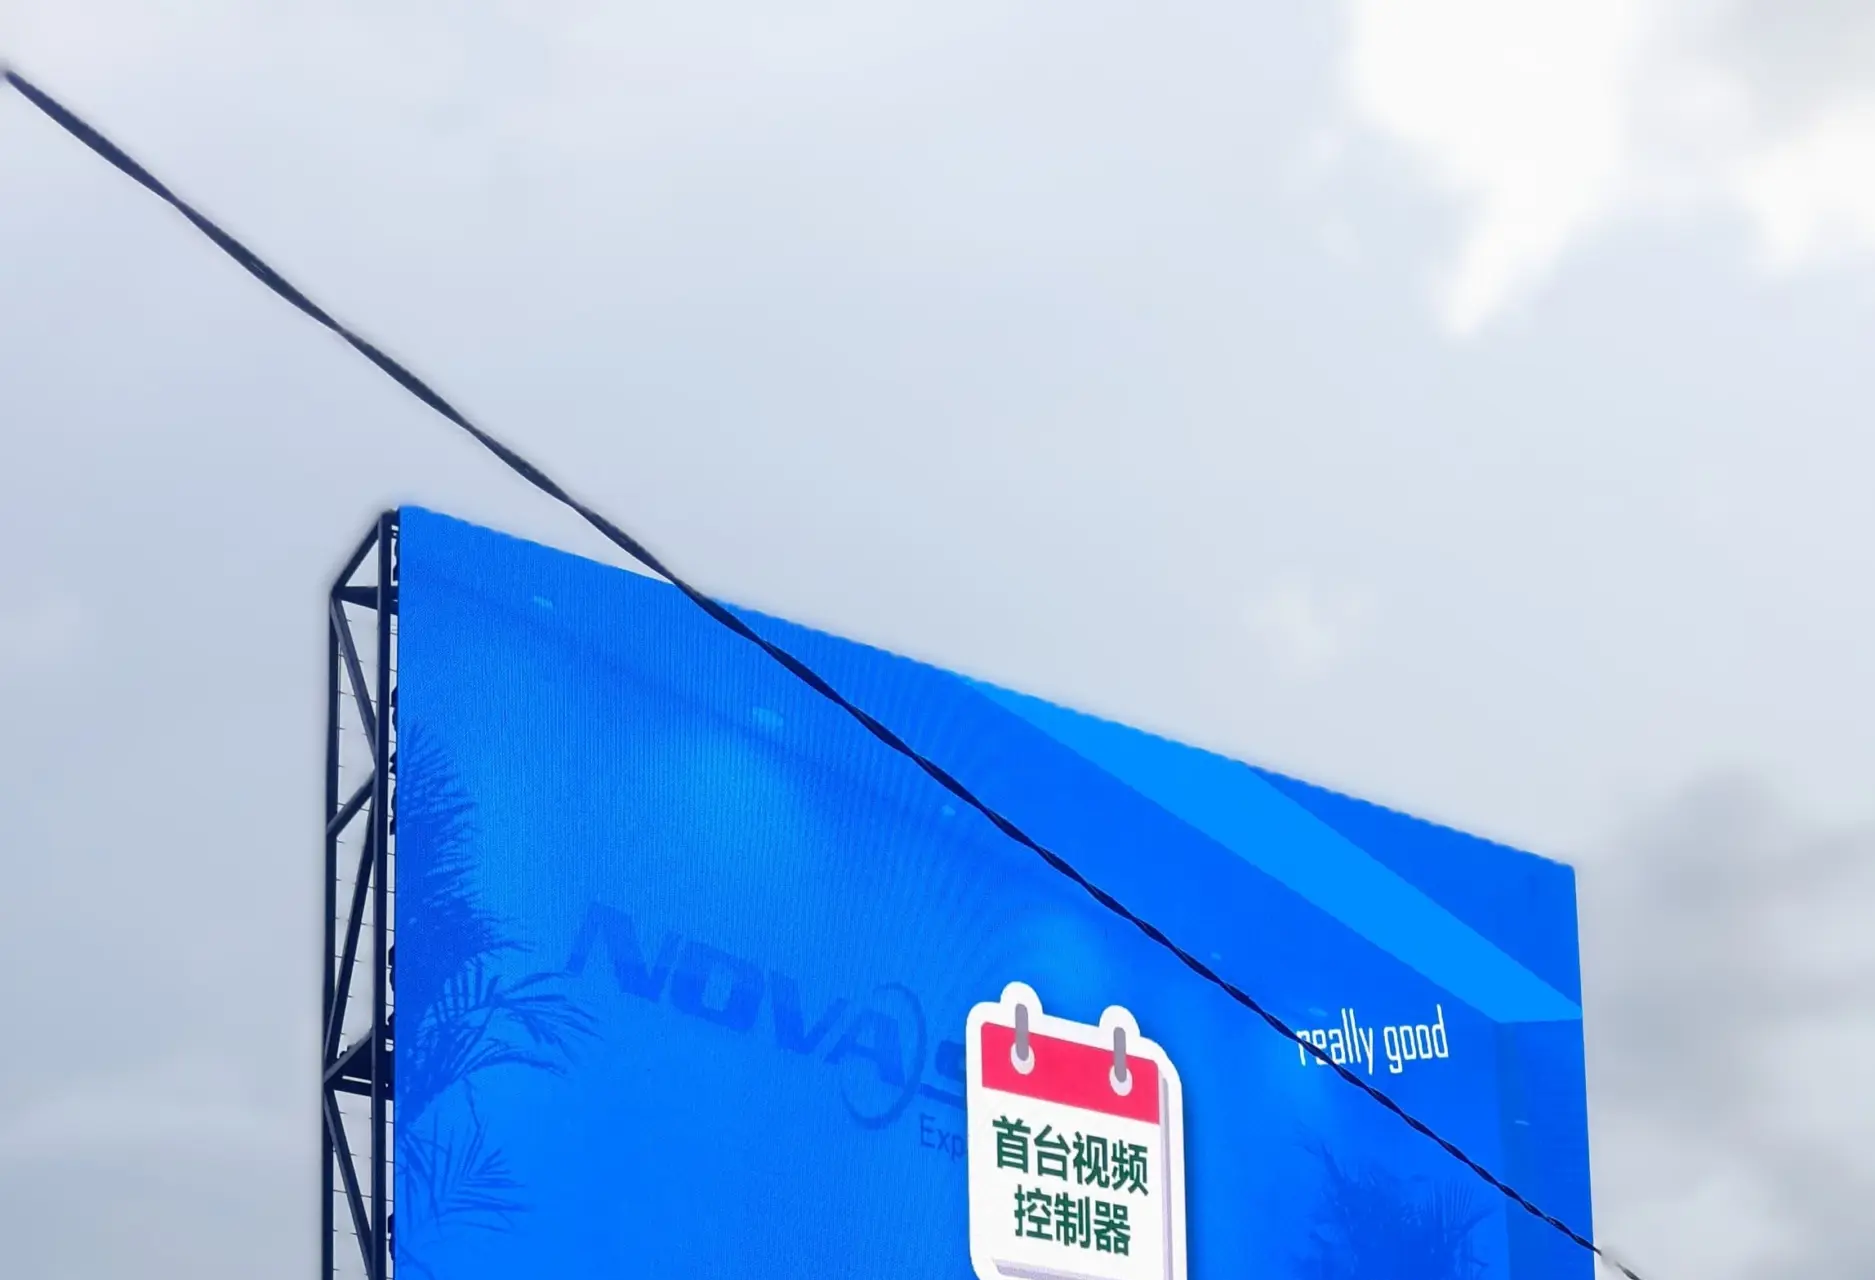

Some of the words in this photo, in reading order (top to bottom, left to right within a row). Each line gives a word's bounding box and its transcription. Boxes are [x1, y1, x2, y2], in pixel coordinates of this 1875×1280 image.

[1296, 1008, 1373, 1075] really
[1384, 1004, 1449, 1074] good
[992, 1115, 1149, 1195] 首台视频
[1013, 1184, 1131, 1256] 控制器
